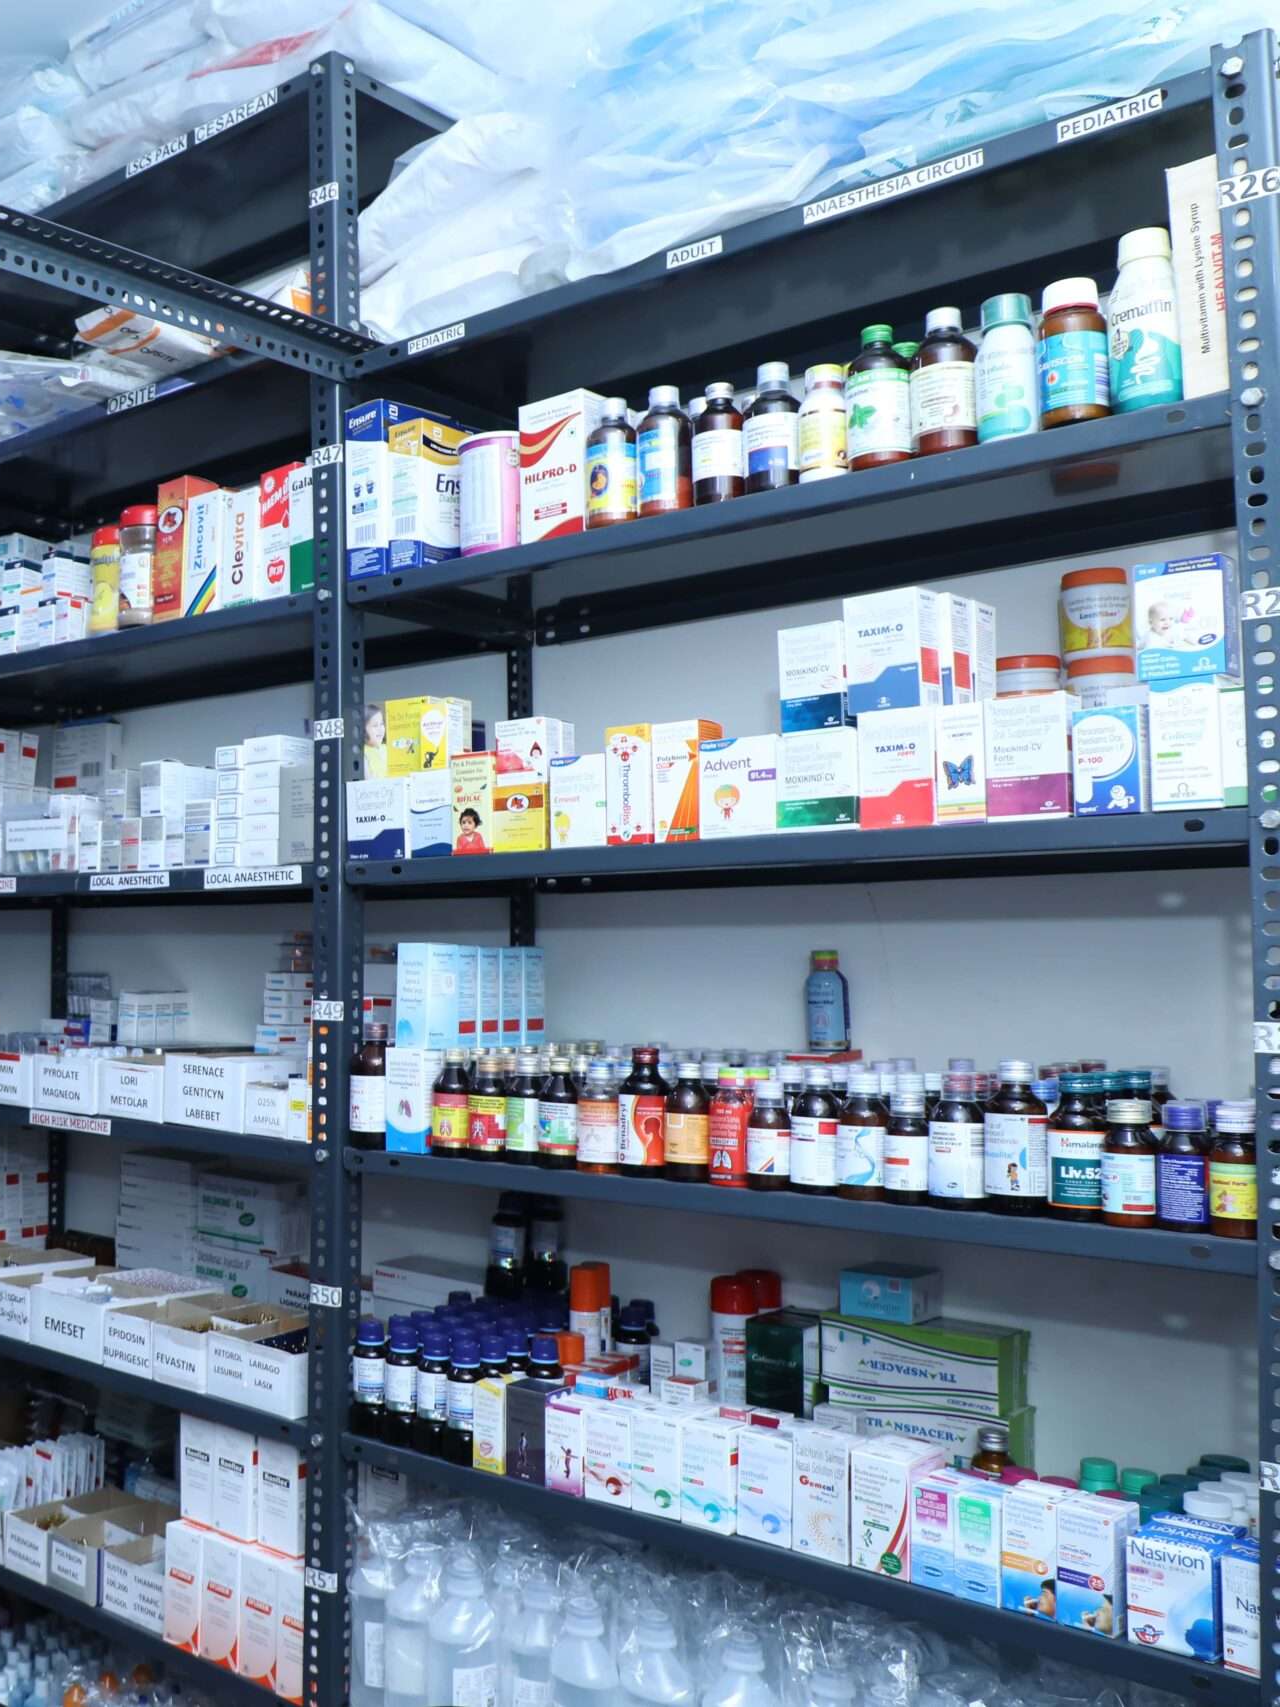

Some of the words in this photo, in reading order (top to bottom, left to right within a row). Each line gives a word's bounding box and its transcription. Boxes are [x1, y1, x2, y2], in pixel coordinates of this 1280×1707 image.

[195, 90, 277, 142] CESAREAN
[1059, 94, 1160, 137] PEDIATRIC
[128, 152, 152, 175] LSCS
[155, 137, 187, 162] PACK
[311, 183, 337, 206] R46
[804, 175, 912, 221] ANAESTHESIA
[916, 151, 983, 184] CIRCUIT
[1218, 168, 1280, 205] R26
[1190, 203, 1201, 234] Syrup
[670, 239, 717, 265] ADULT
[1192, 235, 1204, 269] Lysine
[1195, 269, 1207, 292] with
[409, 326, 465, 353] PEDIATRIC
[108, 385, 156, 413] OPSITE
[348, 409, 377, 429] Ensure
[313, 445, 343, 466] R47
[525, 463, 577, 485] HILPRO-D
[193, 503, 205, 570] Zincovit
[231, 512, 245, 585] Clevira
[858, 623, 904, 639] TAXIM-O
[316, 718, 343, 738] R48
[875, 742, 916, 754] TAXIM-O
[703, 757, 752, 773] Advent
[356, 814, 386, 824] TAXIM-O
[92, 875, 116, 889] LOCAL
[118, 874, 165, 888] ANESTHETIC
[206, 872, 232, 886] LOCAL
[234, 869, 295, 885] ANAESTHETIC
[313, 1001, 343, 1020] R49
[43, 1067, 79, 1081] PYROLATE
[120, 1074, 138, 1086] LORI
[182, 1063, 225, 1078] SERENACE
[42, 1087, 80, 1102] MAGNEON
[110, 1094, 148, 1109] METOLAR
[182, 1085, 224, 1101] GENTICYN
[32, 1113, 48, 1125] HIGH
[50, 1115, 67, 1128] RISK
[69, 1118, 109, 1134] MEDICINE
[1060, 1165, 1101, 1180] Liv.52
[311, 1286, 340, 1306] R50
[44, 1316, 86, 1340] EMESET
[108, 1327, 145, 1346] EPIDOSIN
[104, 1346, 150, 1369] BUPRIGESIC
[156, 1352, 197, 1373] FEVASTIN
[249, 1359, 281, 1375] LARIAGO
[1130, 1539, 1205, 1571] Nasivion
[307, 1570, 337, 1589] R51
